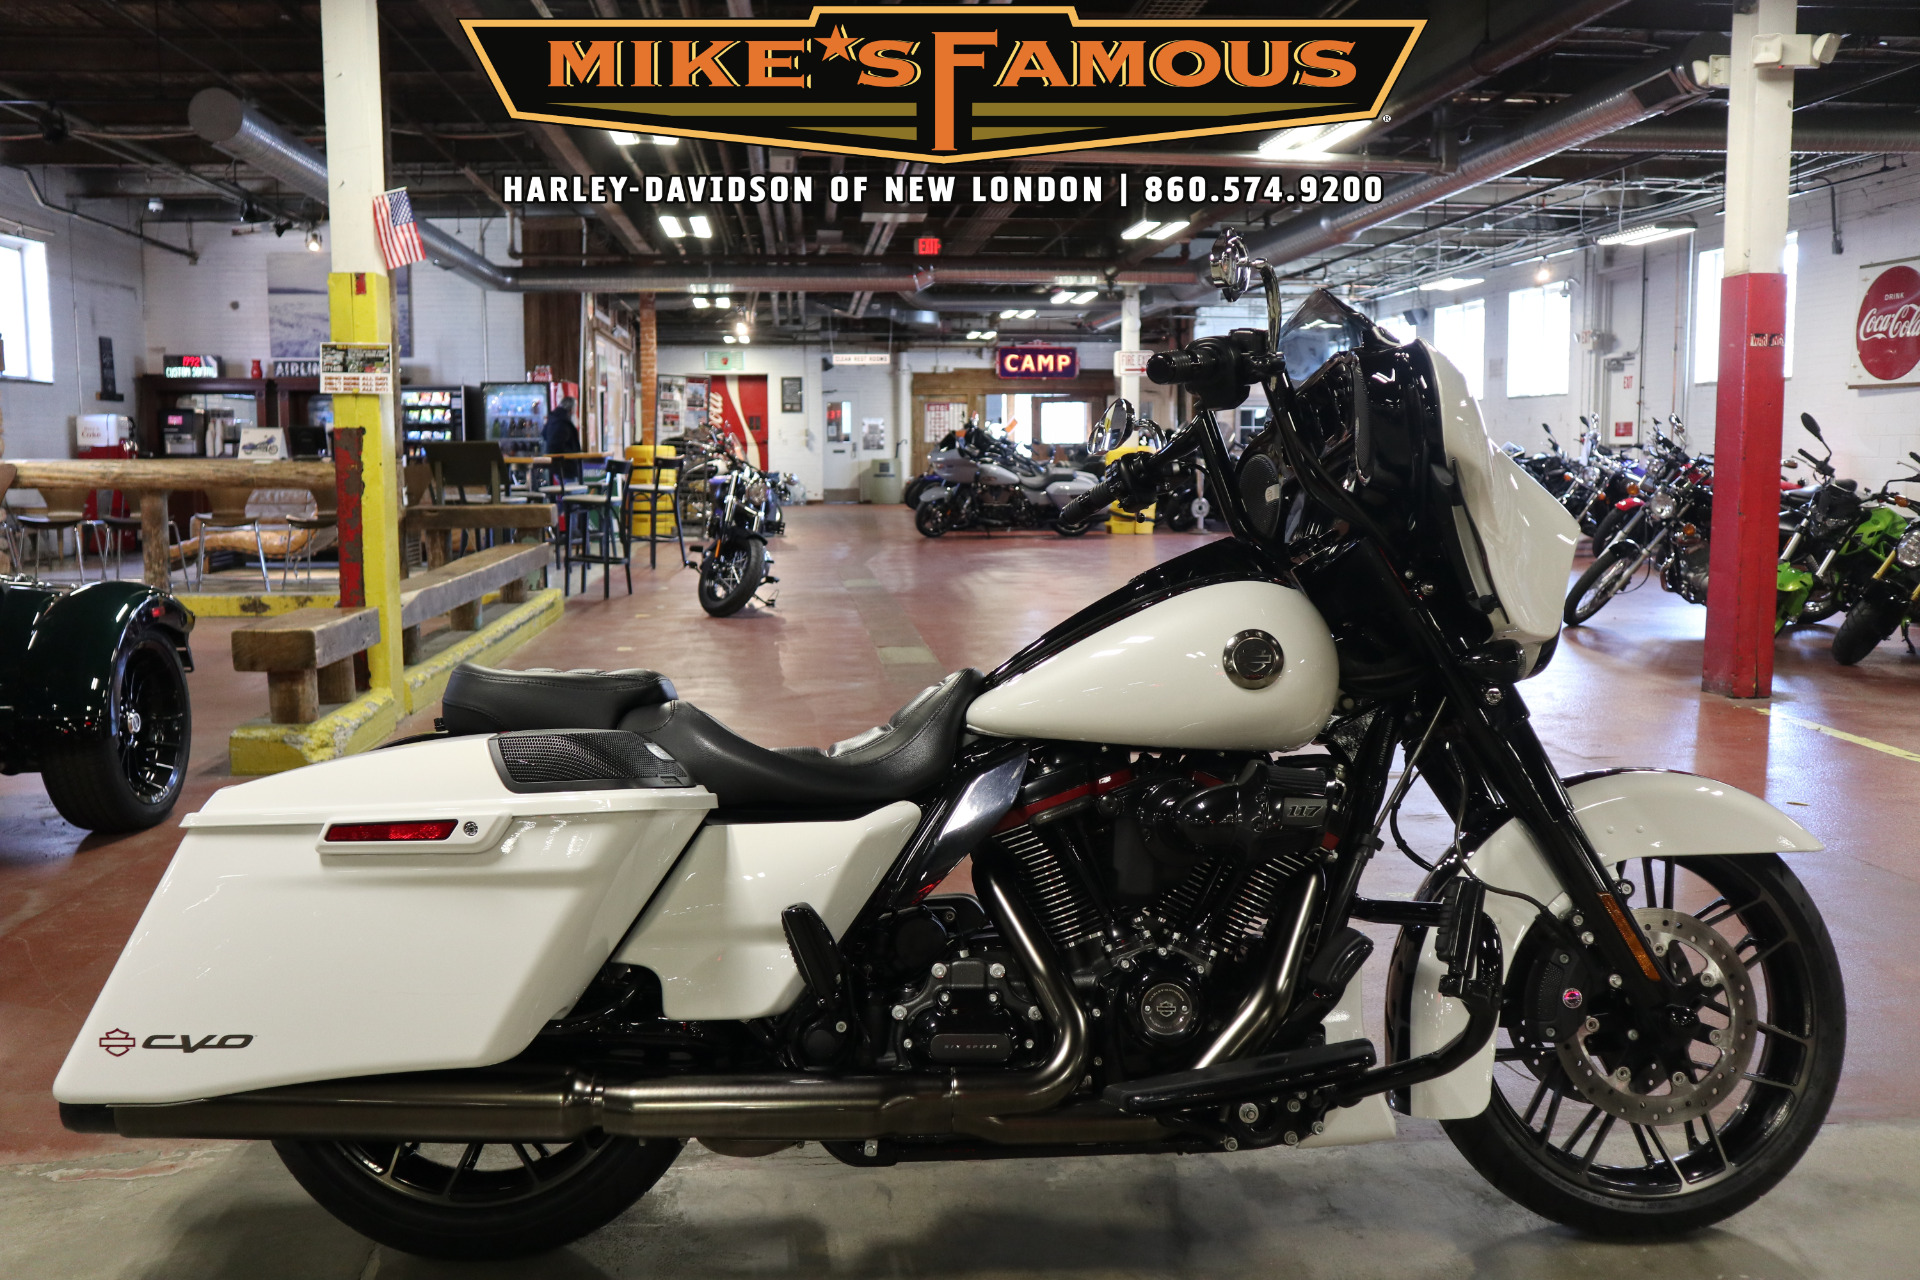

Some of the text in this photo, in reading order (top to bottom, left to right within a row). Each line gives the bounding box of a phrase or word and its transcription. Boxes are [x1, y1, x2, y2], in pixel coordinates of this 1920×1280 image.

[918, 238, 938, 255] EXIT
[1884, 292, 1905, 300] DRINK
[1004, 353, 1071, 372] CAMP
[1122, 355, 1135, 366] FIRE
[1623, 375, 1633, 389] EXIT
[1287, 804, 1323, 817] 117
[142, 1034, 254, 1053] CVO
